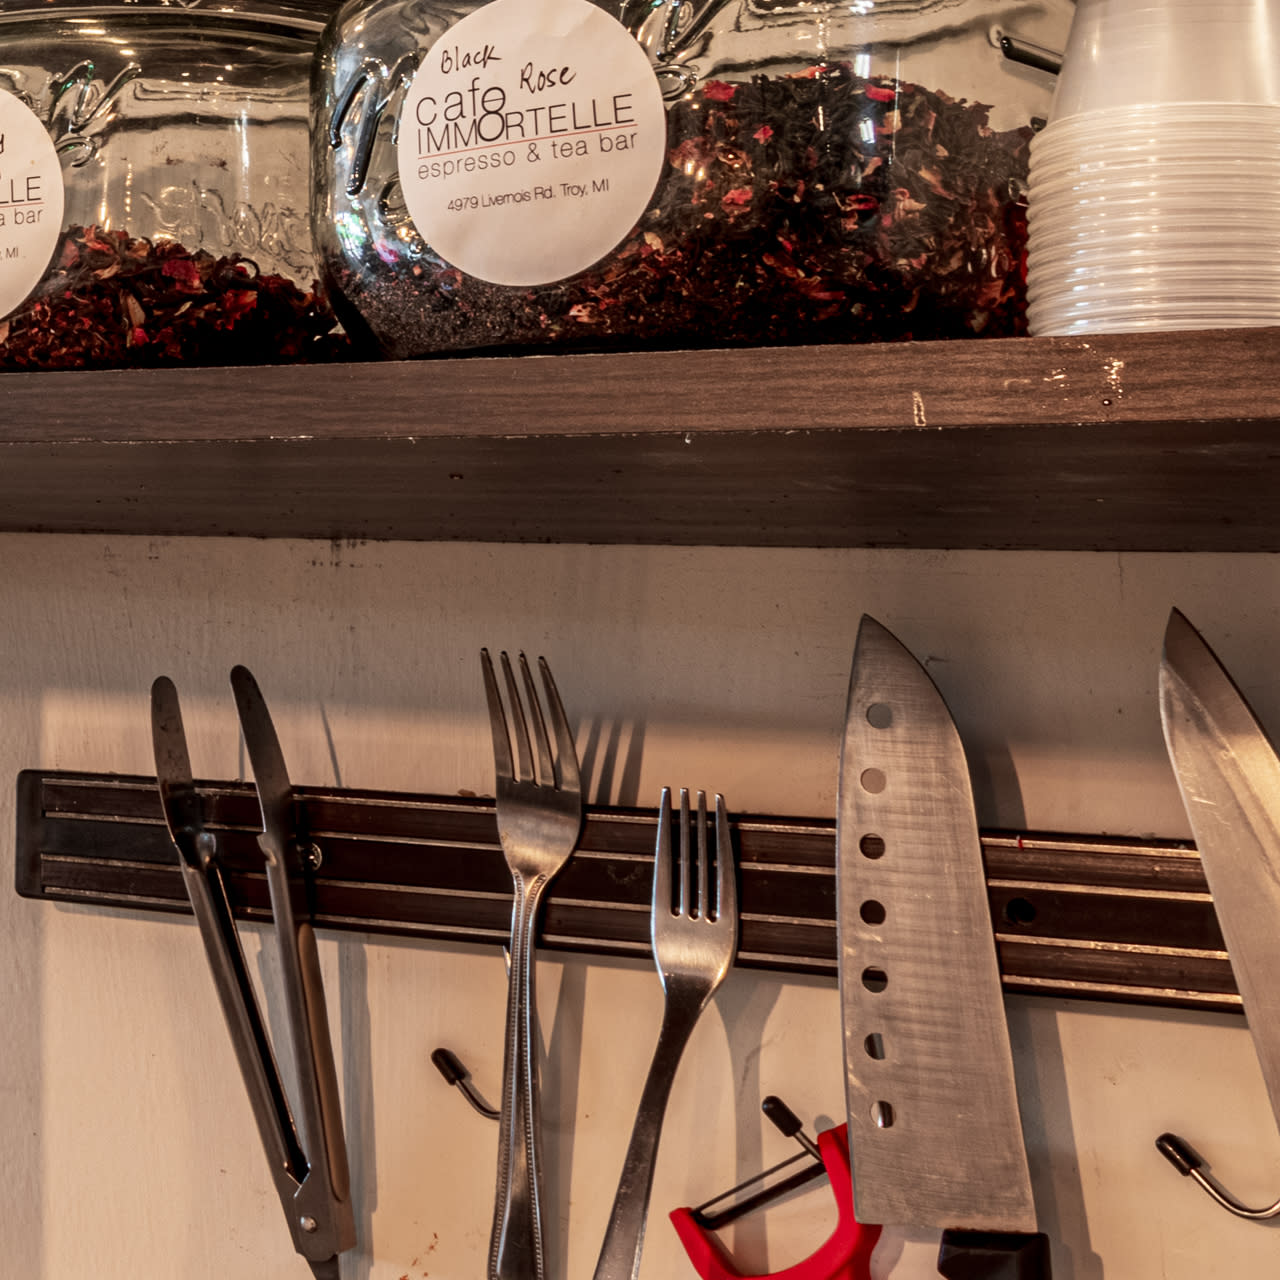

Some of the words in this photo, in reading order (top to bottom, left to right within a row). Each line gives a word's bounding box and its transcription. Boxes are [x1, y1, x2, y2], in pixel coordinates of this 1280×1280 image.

[440, 45, 502, 74] Black
[520, 62, 576, 94] Rose
[416, 77, 505, 127] cafe
[417, 94, 634, 154] IMMORTELLE
[418, 151, 516, 180] espresso
[527, 143, 540, 163] &
[551, 138, 588, 159] tea
[599, 133, 636, 152] bar
[14, 208, 43, 224] bar
[448, 196, 478, 211] 4979
[593, 179, 610, 193] MI
[6, 248, 18, 258] MI
